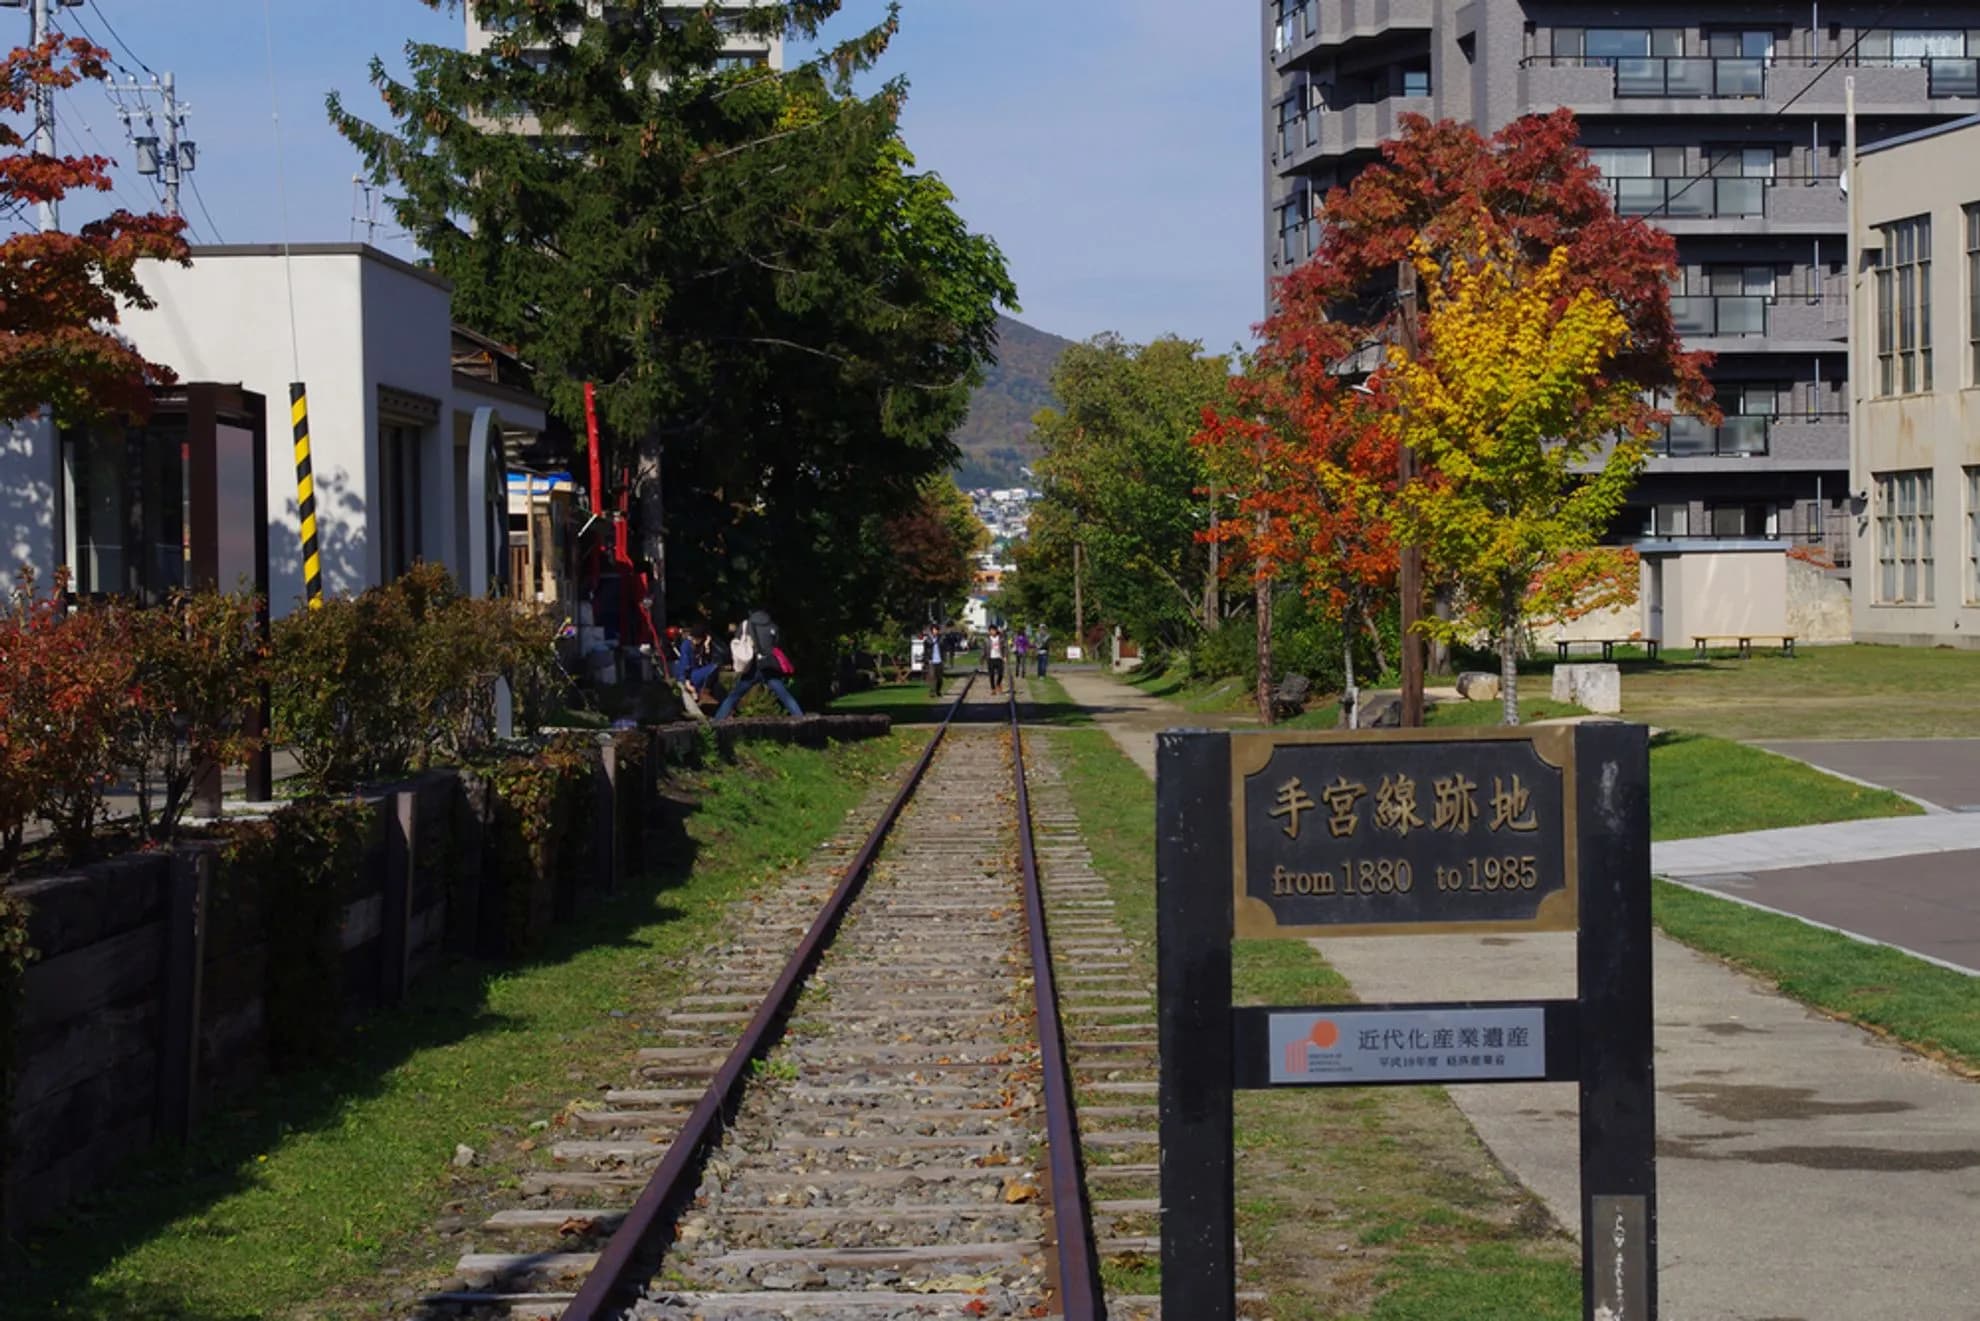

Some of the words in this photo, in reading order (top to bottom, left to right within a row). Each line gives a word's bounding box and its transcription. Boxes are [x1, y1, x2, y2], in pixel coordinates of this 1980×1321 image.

[1268, 773, 1539, 838] 手宮線跡地
[1272, 865, 1336, 896] from
[1342, 857, 1412, 894] 1880
[1436, 864, 1462, 891] to
[1467, 855, 1537, 890] 1985
[1358, 1026, 1529, 1050] 近代化産業遺産
